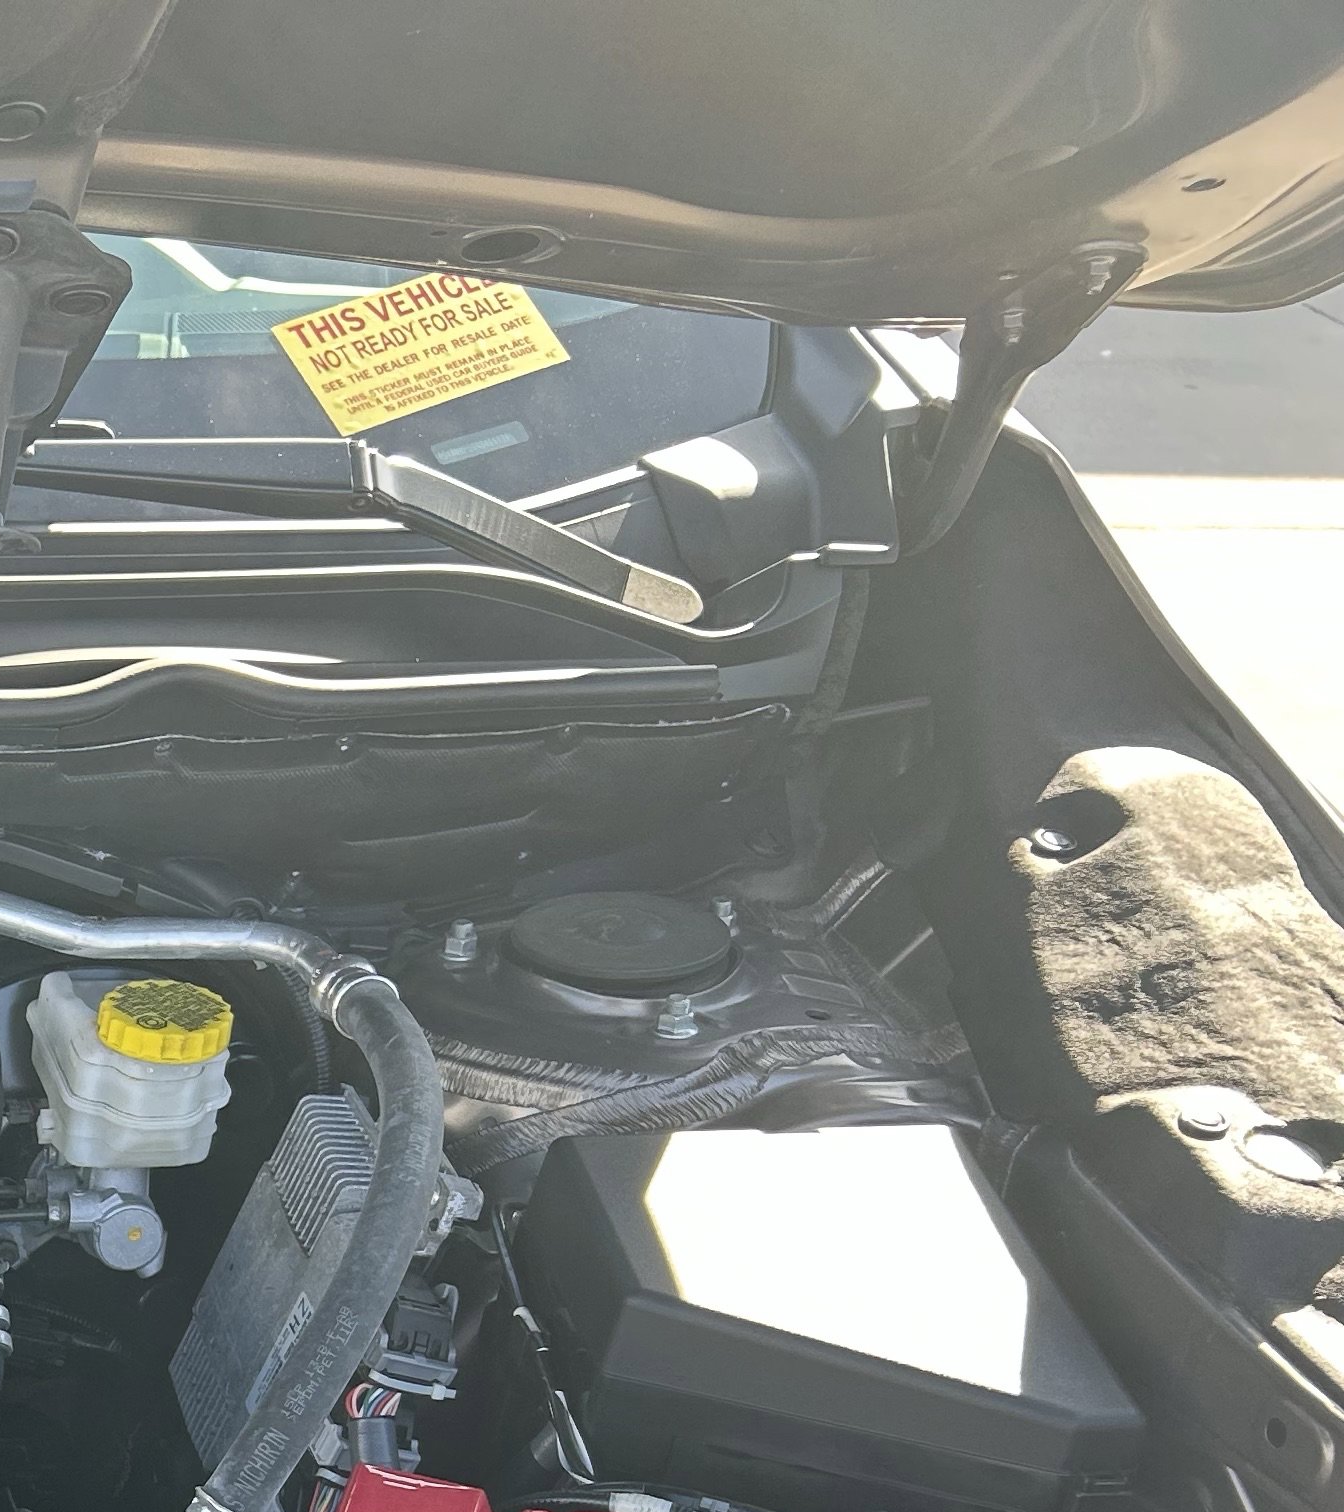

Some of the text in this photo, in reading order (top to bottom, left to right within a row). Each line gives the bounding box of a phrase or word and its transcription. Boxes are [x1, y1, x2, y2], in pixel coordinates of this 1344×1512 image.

[287, 308, 366, 349] THIS
[308, 292, 513, 374] NOT READY FOR SALE
[322, 315, 531, 394] SEE THE DEALER FOR RESALE DATE
[344, 336, 533, 406] THIS STICKER MUST REMAIN IN PLACE
[347, 402, 375, 415] UNTIL
[375, 398, 384, 406] A
[384, 384, 425, 402] FEDERAL
[426, 374, 451, 388] USED
[452, 367, 472, 378] CAR
[473, 354, 509, 371] BUYERS
[509, 343, 539, 359] GUIDE
[397, 390, 435, 409] AFFIXED
[436, 385, 449, 395] TO
[450, 376, 472, 390] THIS
